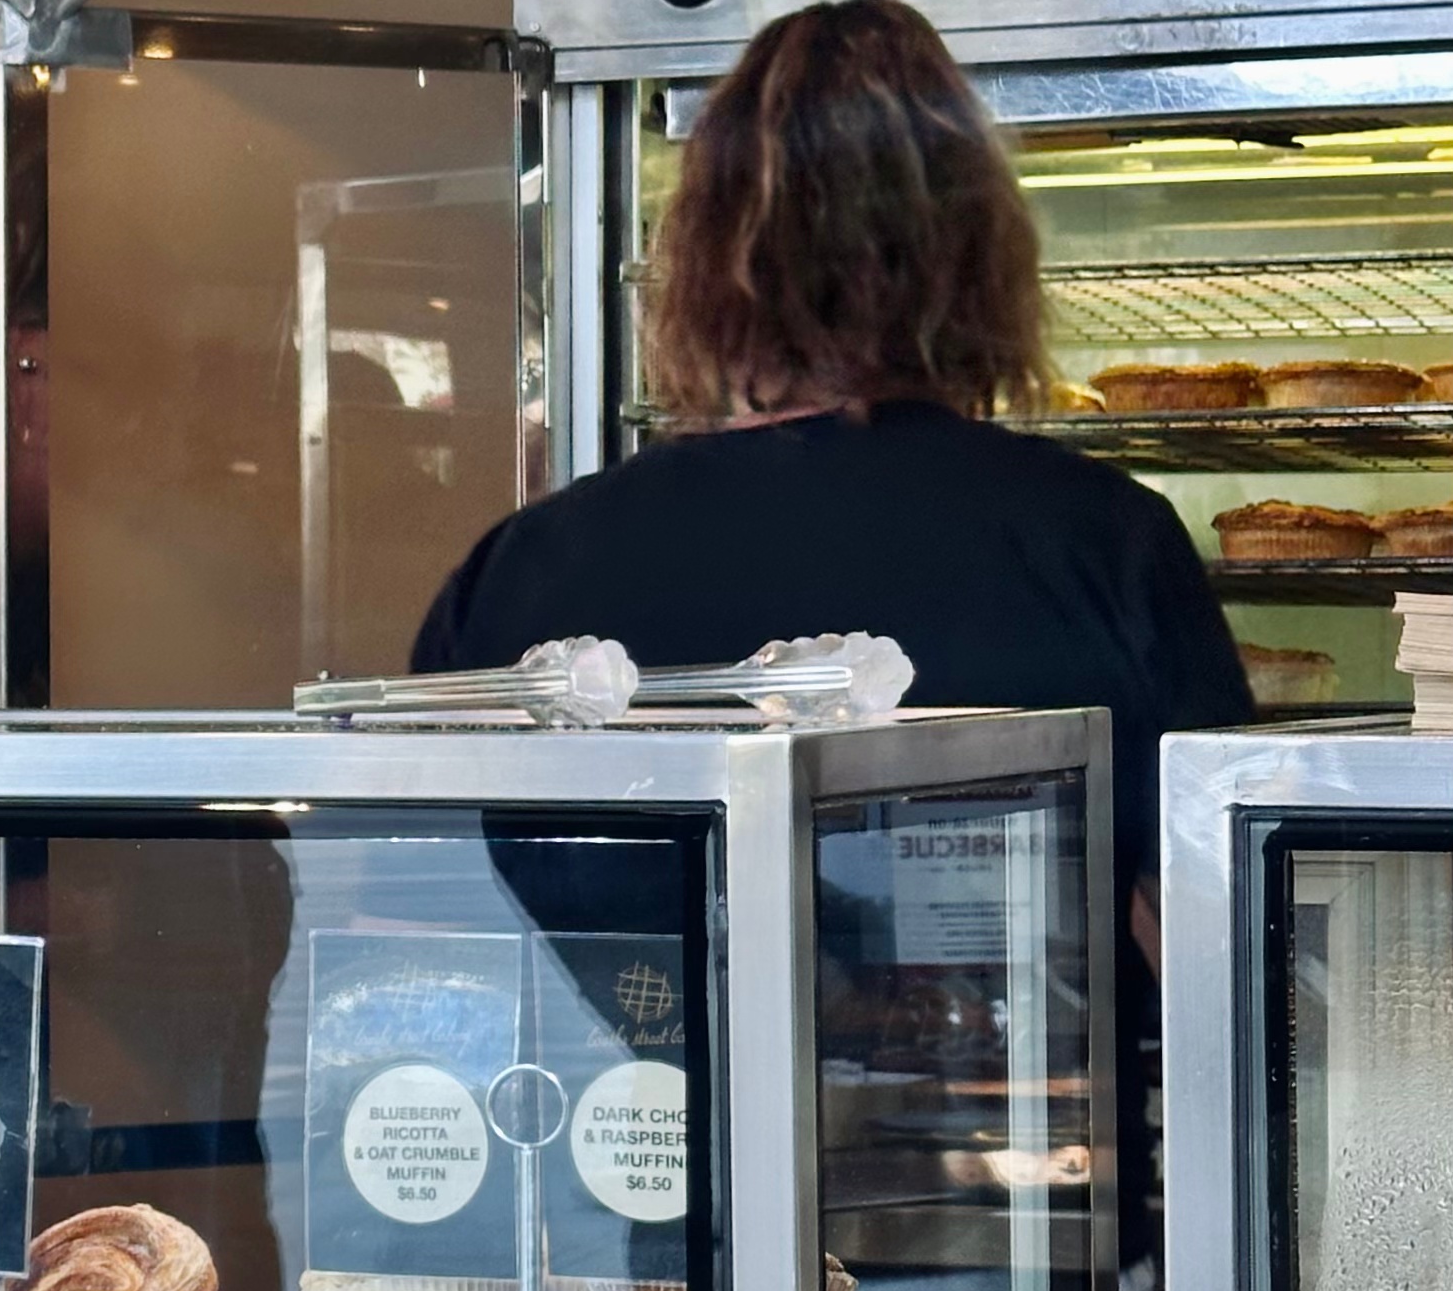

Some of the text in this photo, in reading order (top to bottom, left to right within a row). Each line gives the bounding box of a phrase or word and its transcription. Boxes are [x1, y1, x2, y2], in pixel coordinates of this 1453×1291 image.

[369, 1106, 461, 1121] BLUEBERRY
[592, 1106, 644, 1123] DARK
[383, 1126, 449, 1141] RICOTTA
[583, 1128, 595, 1144] &
[354, 1147, 480, 1162] & OAT CRUMBLE
[613, 1152, 684, 1169] MUFFIN
[386, 1166, 447, 1181] MUFFIN
[626, 1174, 672, 1192] $6.50
[397, 1186, 437, 1202] $6.50
